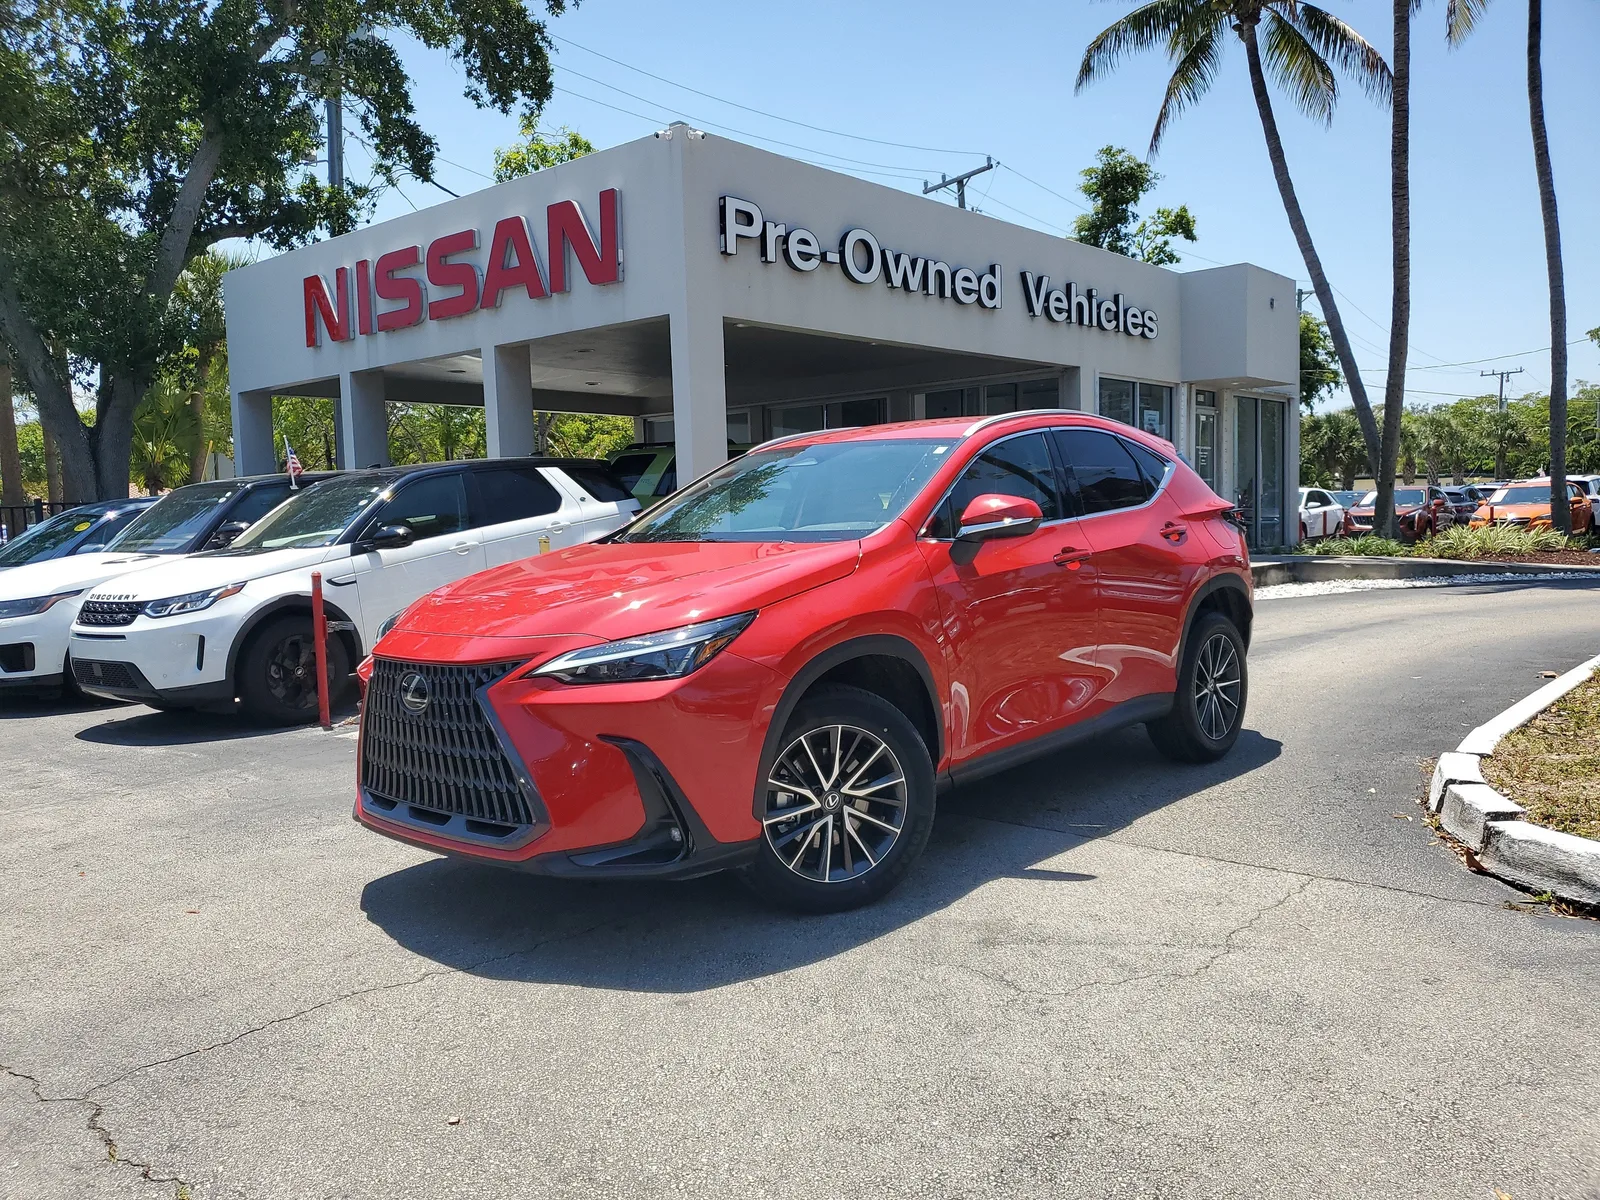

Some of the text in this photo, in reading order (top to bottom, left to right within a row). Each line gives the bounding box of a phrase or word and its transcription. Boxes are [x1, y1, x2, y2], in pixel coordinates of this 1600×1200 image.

[303, 187, 624, 348] NISSAN
[719, 196, 1159, 339] Pre-Owned Vehicles
